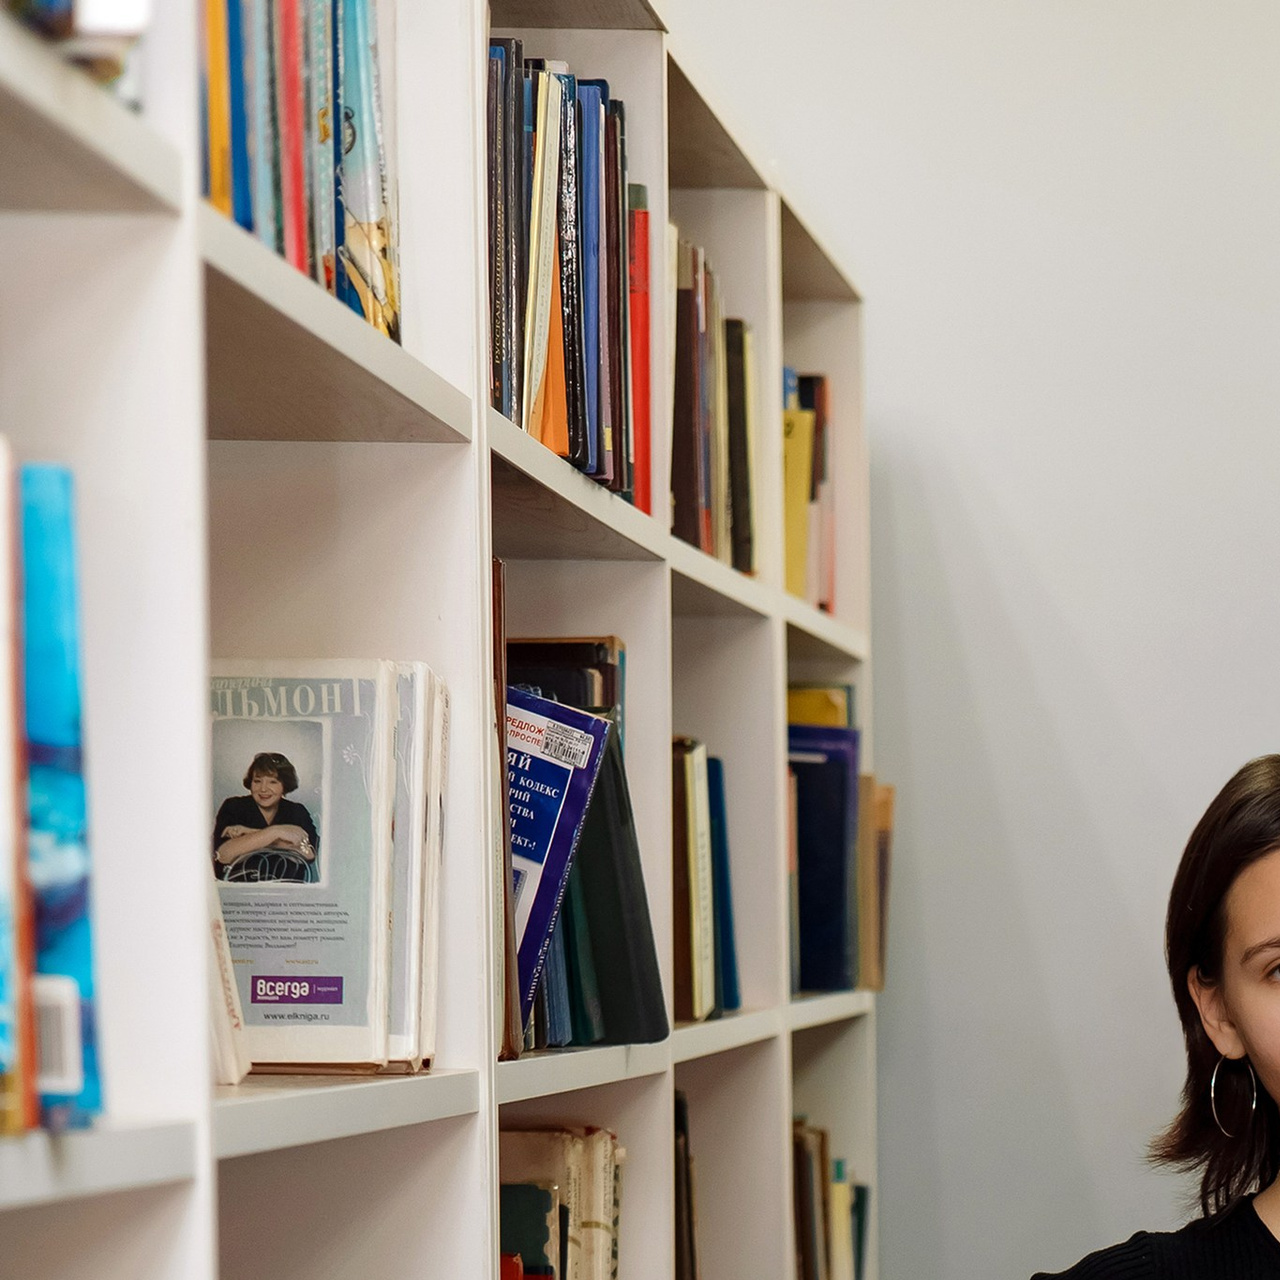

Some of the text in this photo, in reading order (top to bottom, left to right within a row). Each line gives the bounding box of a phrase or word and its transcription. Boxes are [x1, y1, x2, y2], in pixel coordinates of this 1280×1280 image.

[213, 678, 364, 717] ЛЬМОНТ
[519, 776, 560, 799] КОДЕКС
[264, 1013, 330, 1022] www.elkniga.ru
